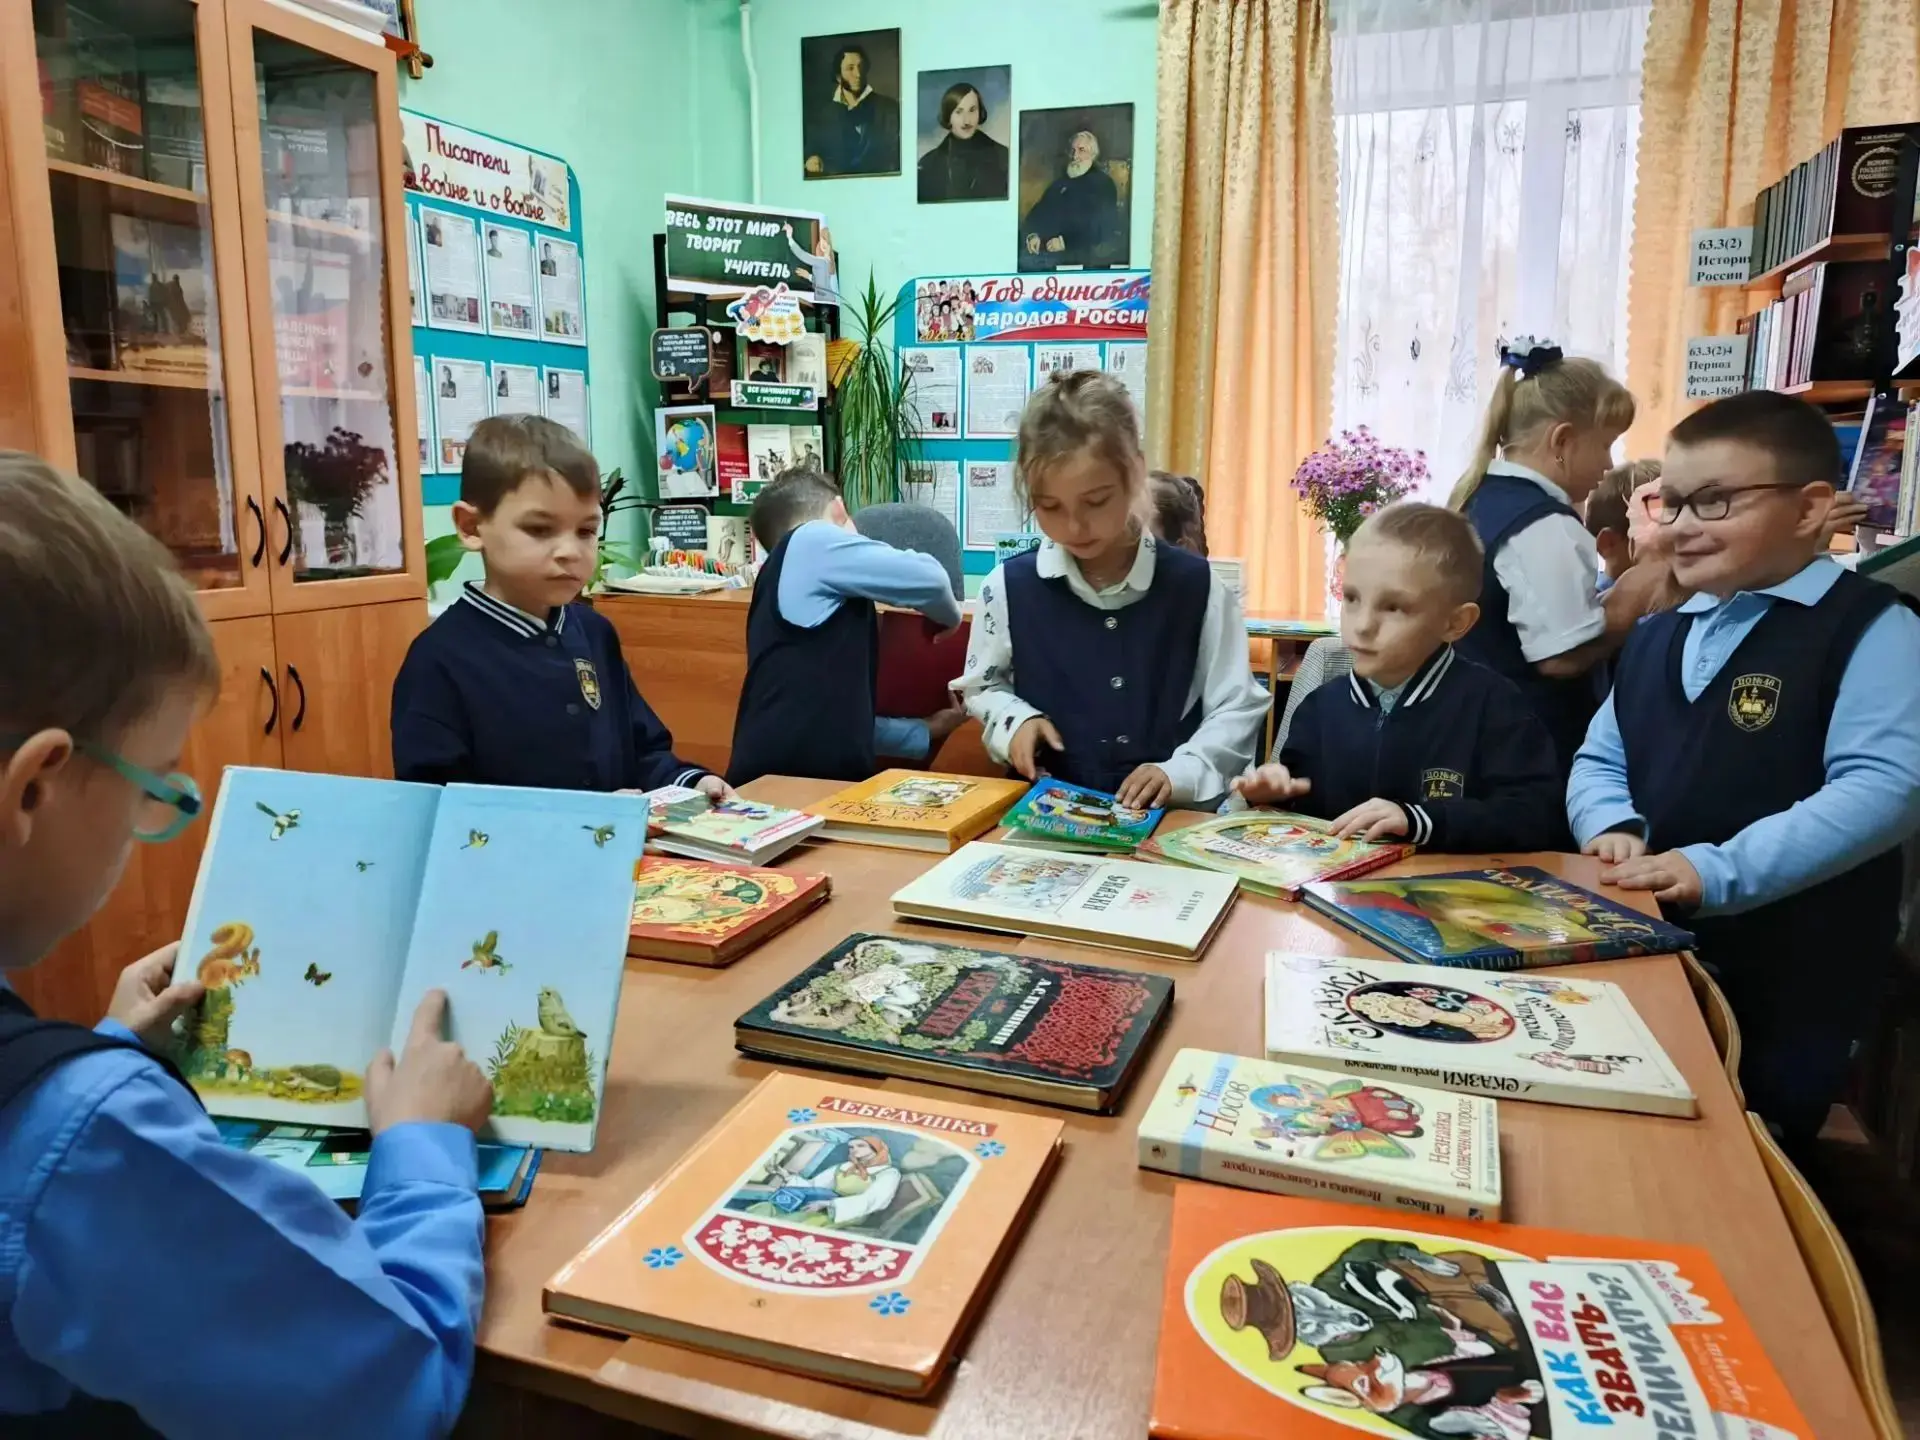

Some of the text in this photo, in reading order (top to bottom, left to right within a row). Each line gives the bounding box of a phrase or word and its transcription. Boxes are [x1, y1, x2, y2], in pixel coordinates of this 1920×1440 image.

[425, 123, 510, 174] Писатели
[421, 164, 469, 202] войне
[473, 189, 486, 206] и
[491, 195, 500, 209] о
[503, 186, 545, 221] войне
[666, 210, 780, 238] ВЕСЬ ЭТОТ МИР
[686, 234, 742, 254] ТВОРИТ
[1698, 238, 1742, 251] 63.3(2)
[724, 258, 791, 279] УЧИТЕЛЬ
[1697, 271, 1742, 282] России
[978, 277, 1024, 302] Год
[973, 306, 1148, 329] народов Росси
[1689, 346, 1732, 357] 63.3(2)4
[1689, 360, 1731, 371] Период
[1081, 874, 1130, 911] СКАЗКИ
[1314, 971, 1384, 1038] СКАЗКИ
[1514, 1003, 1552, 1040] русских
[1524, 997, 1576, 1051] писателей
[1344, 1059, 1519, 1092] СКАЗКИ русских писателей
[1194, 1080, 1250, 1136] Носов
[1429, 1110, 1453, 1166] Незнайка
[1450, 1097, 1481, 1190] в Солнечном городе
[1221, 1159, 1256, 1176] городе
[1258, 1166, 1319, 1188] Солнечном
[1325, 1180, 1381, 1202] Незнайка
[1396, 1196, 1430, 1213] Носов
[1529, 1280, 1615, 1425] КАК ВАС
[1571, 1292, 1645, 1418] ЗВАТЬ-
